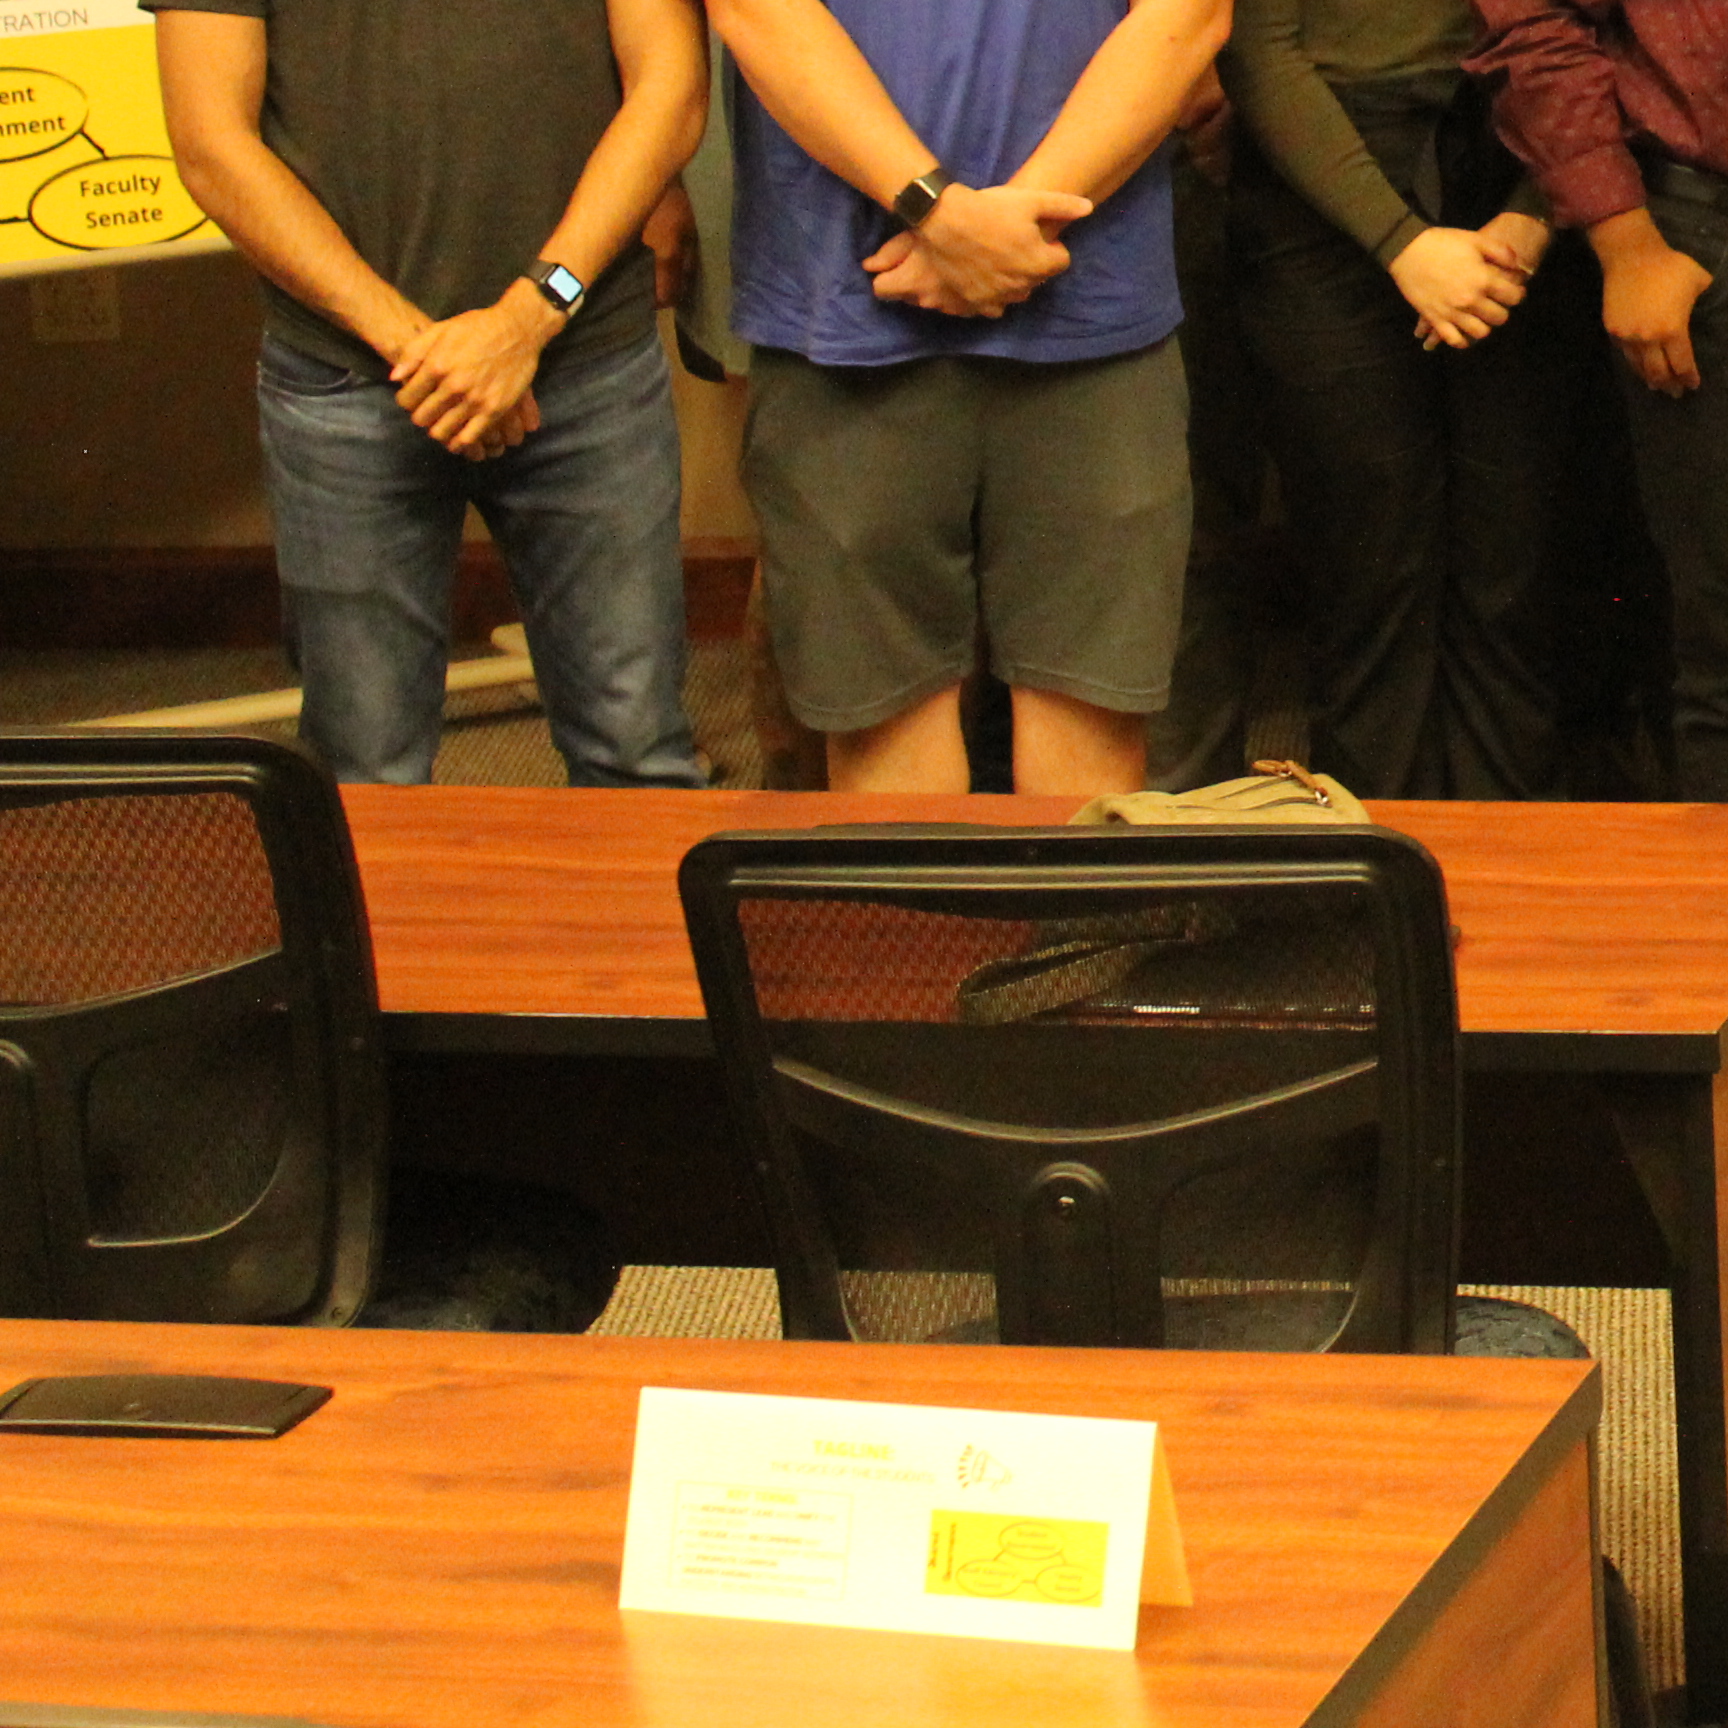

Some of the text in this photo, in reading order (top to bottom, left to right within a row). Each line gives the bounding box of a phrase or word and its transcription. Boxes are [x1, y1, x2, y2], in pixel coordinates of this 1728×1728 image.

[0, 8, 88, 33] RATION
[80, 174, 161, 198] Faculty
[85, 207, 164, 229] Senate
